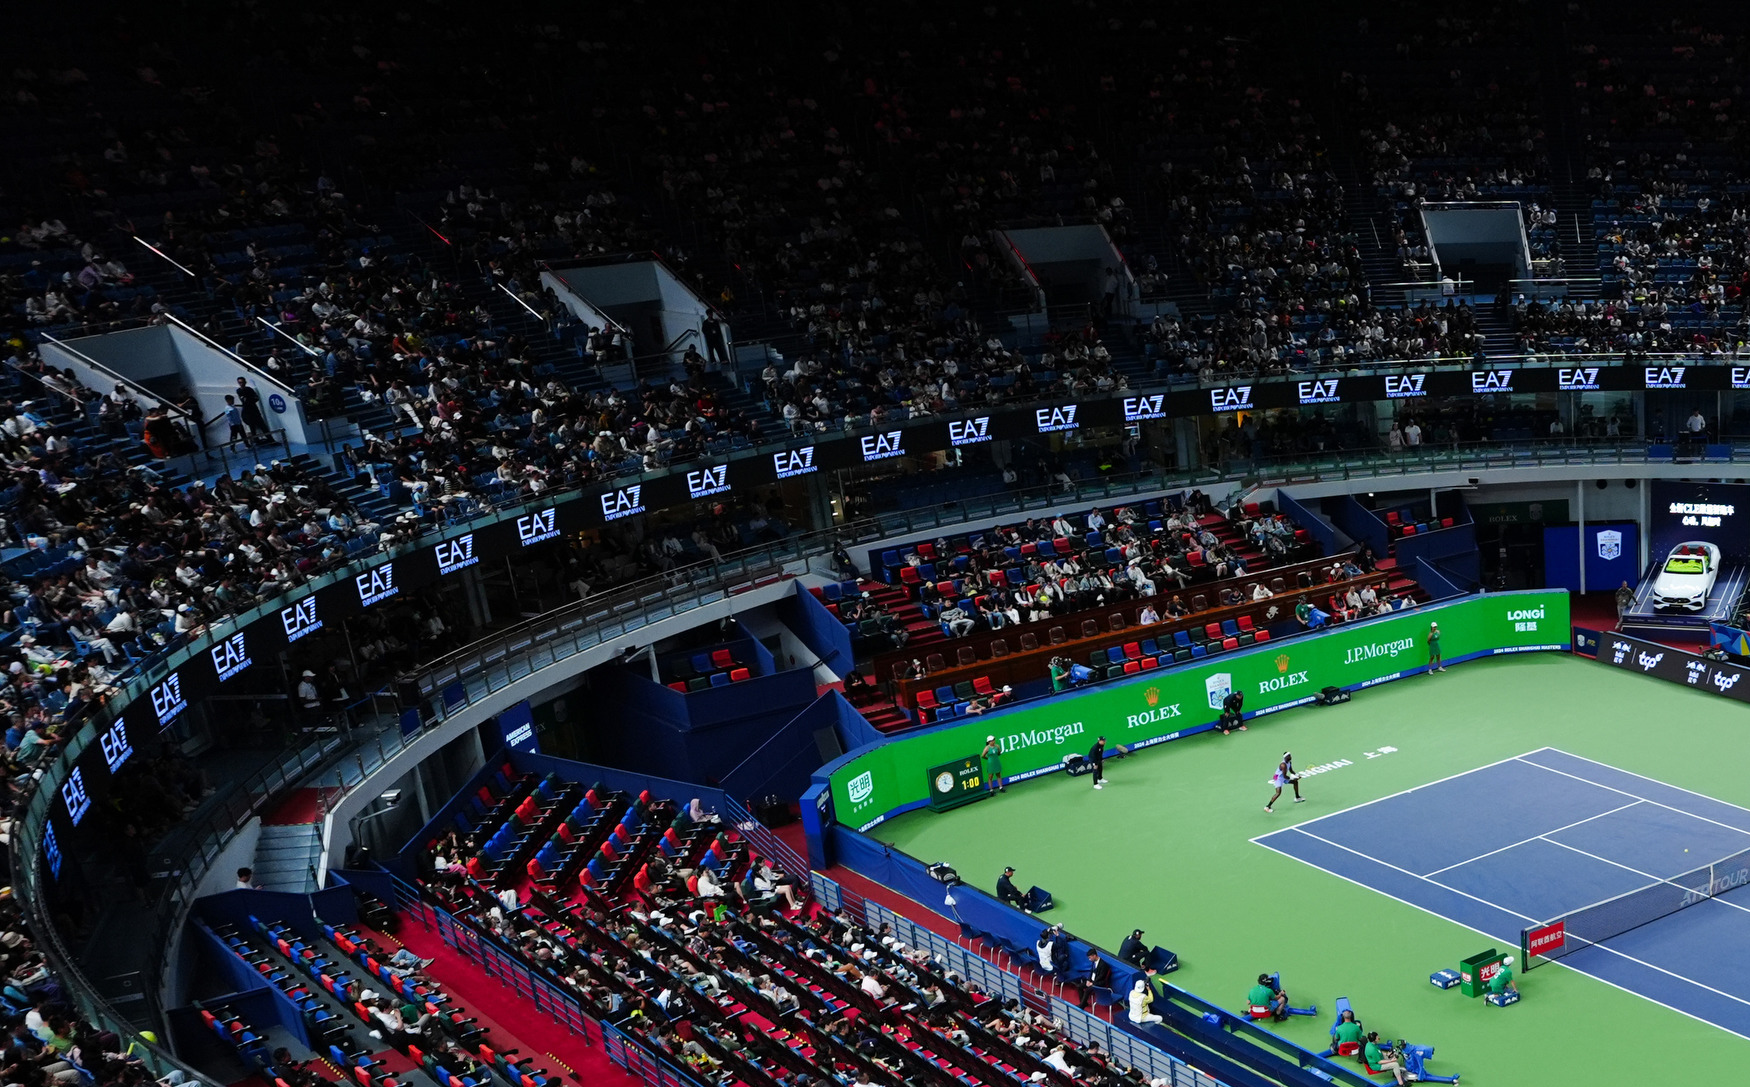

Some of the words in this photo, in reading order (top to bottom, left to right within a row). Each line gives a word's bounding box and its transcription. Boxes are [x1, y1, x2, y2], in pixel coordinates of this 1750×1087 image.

[1385, 375, 1425, 393] EA7
[1472, 370, 1512, 388] EA7
[1559, 368, 1599, 385] EA7
[1645, 367, 1685, 384] EA7
[1211, 387, 1251, 407] EA7
[1298, 380, 1338, 399] EA7
[1036, 405, 1076, 427] EA7
[1124, 395, 1164, 416] EA7
[949, 417, 989, 441] EA7
[861, 431, 901, 456] EA7
[774, 447, 813, 473] EA7
[687, 465, 727, 493] EA7
[601, 485, 640, 515] EA7
[517, 508, 555, 540] EA7
[435, 533, 472, 568] EA7
[356, 563, 392, 599] EA7
[281, 596, 316, 635] EA7
[211, 632, 245, 674] EA7
[1344, 637, 1414, 664] J.P.Morgan
[1639, 650, 1657, 670] tcp
[1259, 670, 1309, 694] ROLEX
[1715, 671, 1734, 691] tcp
[151, 673, 181, 717] EA7
[1127, 703, 1182, 729] ROLEX
[100, 717, 127, 765] EA7
[506, 722, 531, 742] AMERICAN
[511, 731, 532, 747] EXPRESS
[999, 720, 1084, 754] J.P.Morgan
[960, 766, 978, 776] ROLEX
[962, 776, 980, 790] 1:00
[849, 773, 872, 796] 光明
[1680, 886, 1708, 907] ATP
[1713, 869, 1748, 894] TOUR
